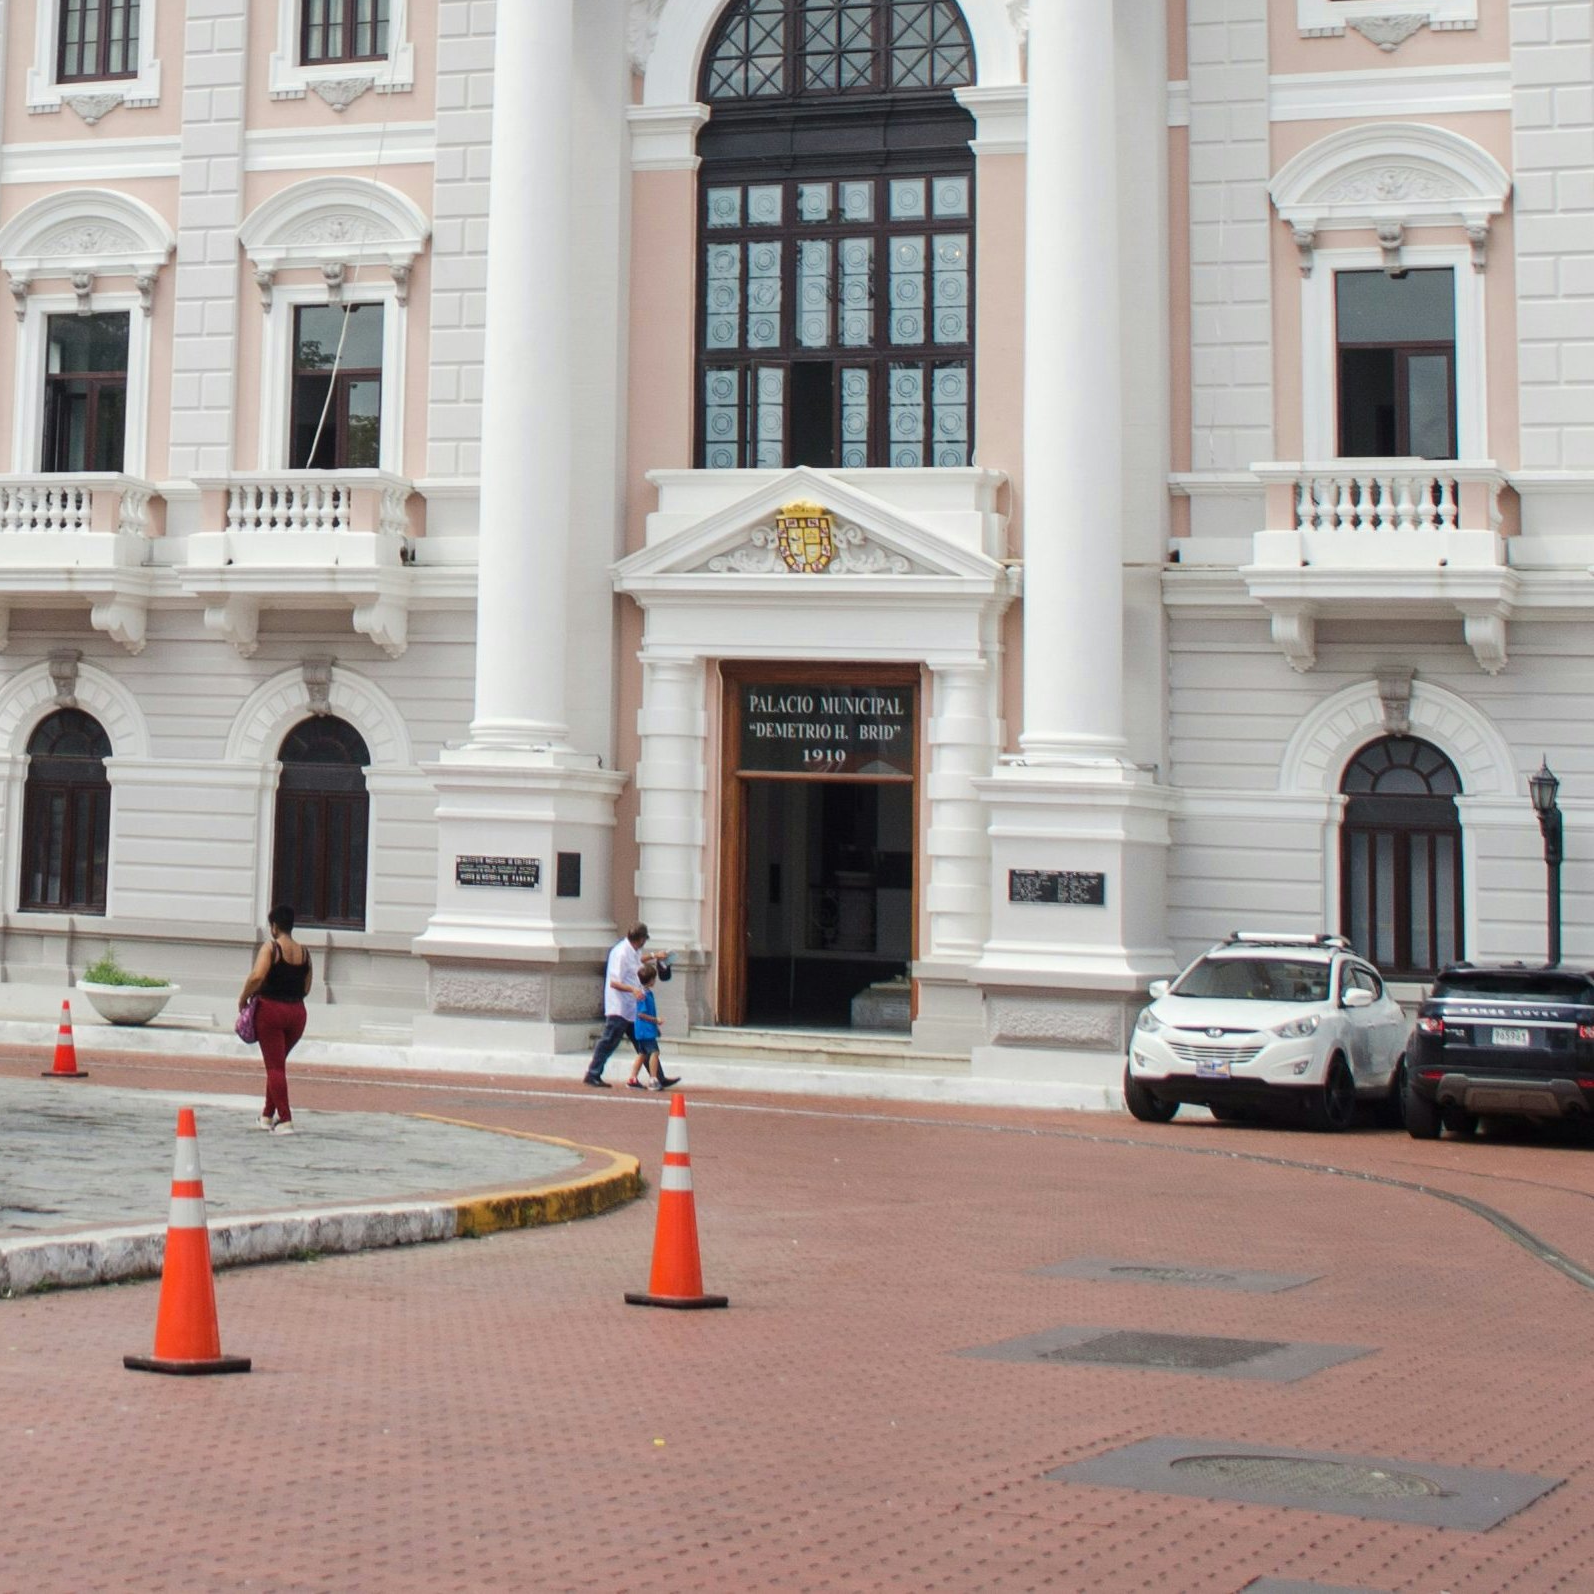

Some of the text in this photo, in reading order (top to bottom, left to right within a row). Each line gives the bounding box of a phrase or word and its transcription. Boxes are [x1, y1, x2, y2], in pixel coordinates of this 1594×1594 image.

[749, 695, 904, 716] PALACIO MUNICIPAL
[749, 722, 901, 741] “DEMETRIO H. BRID”
[802, 749, 846, 763] 1910
